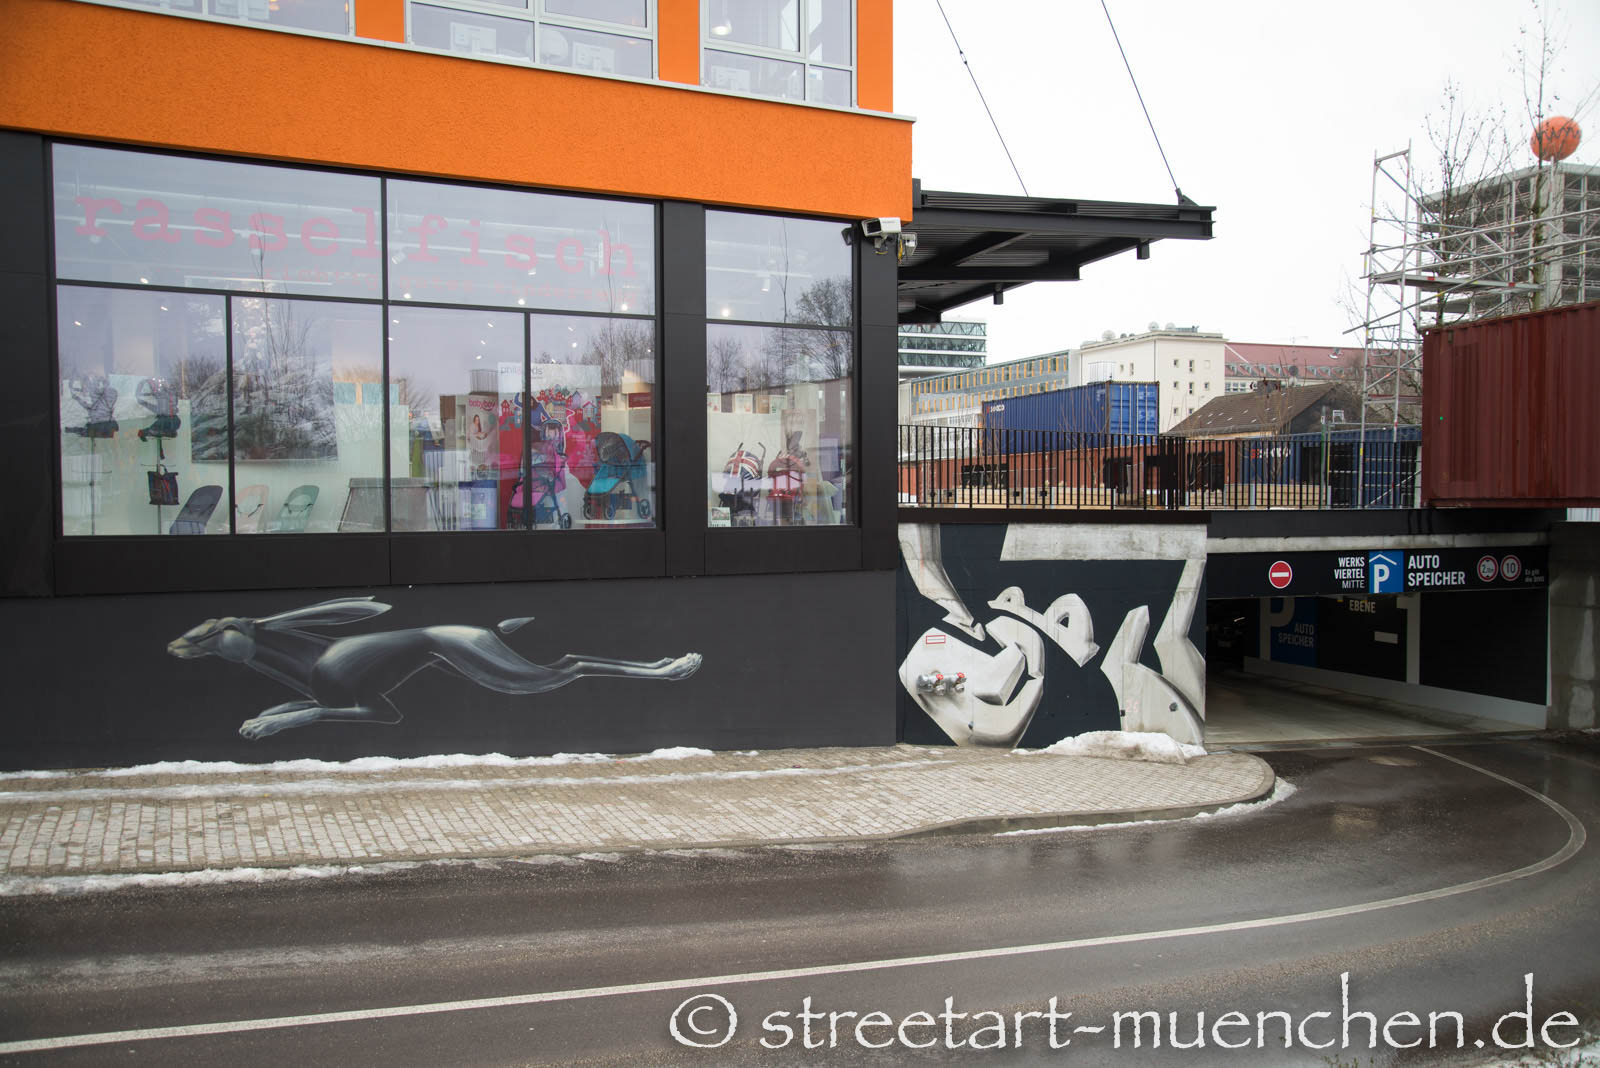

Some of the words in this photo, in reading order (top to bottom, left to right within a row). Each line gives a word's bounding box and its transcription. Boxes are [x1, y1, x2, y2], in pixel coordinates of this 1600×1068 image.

[1338, 556, 1365, 568] WERKS
[1407, 554, 1440, 570] AUTO
[1506, 562, 1516, 574] 10
[1334, 568, 1365, 580] VIERTEL
[1373, 563, 1390, 594] P
[1407, 571, 1466, 587] SPEICHER
[1342, 579, 1365, 589] MITTE
[1349, 599, 1376, 614] EBENE
[1294, 623, 1315, 635] AUTO
[1277, 632, 1315, 648] SPEICHER
